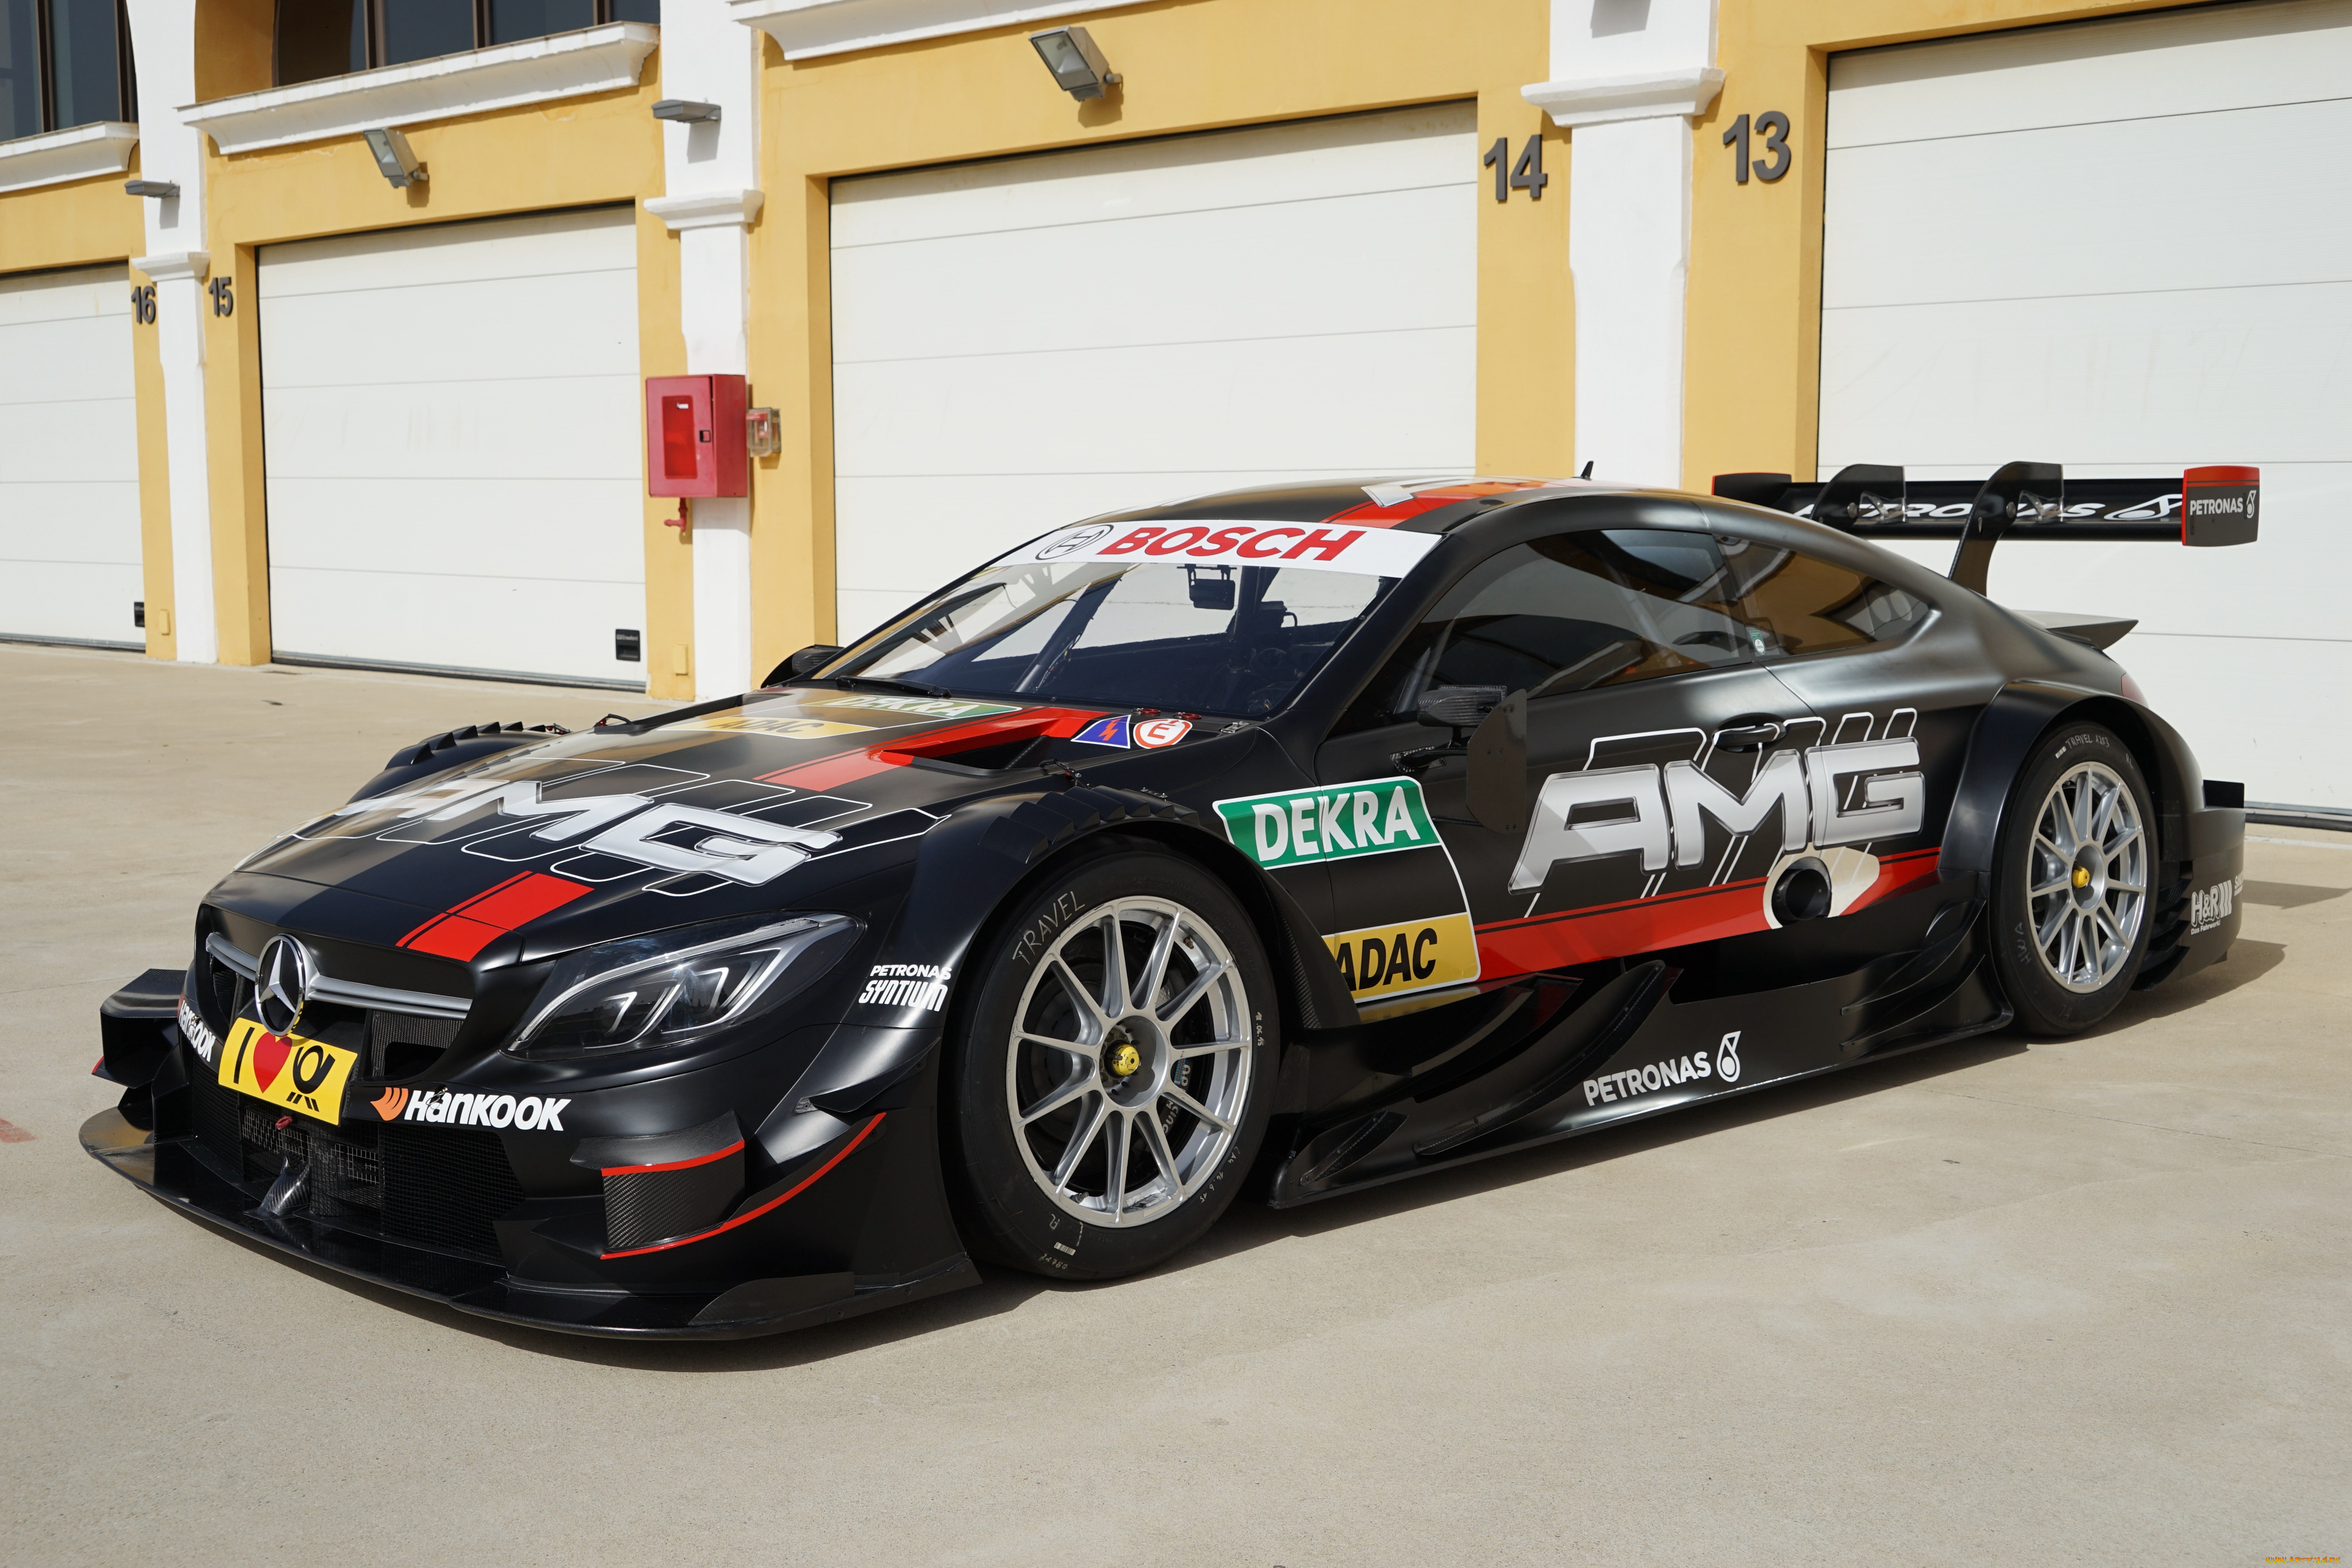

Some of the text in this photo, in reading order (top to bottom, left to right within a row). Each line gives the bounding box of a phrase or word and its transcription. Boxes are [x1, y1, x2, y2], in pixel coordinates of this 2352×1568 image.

[1723, 111, 1791, 183] 13
[1483, 134, 1548, 202] 14
[131, 286, 156, 324] 16
[208, 277, 233, 316] 15
[2190, 497, 2243, 515] PETRONAS
[1096, 526, 1367, 561] BOSCH
[704, 719, 825, 733] ADAC
[822, 696, 980, 717] DEKRA
[2065, 734, 2092, 749] TRAVEL
[333, 778, 843, 887] AMG
[1252, 785, 1421, 861] DEKRA
[1508, 737, 1925, 895] AMG
[2191, 885, 2221, 927] H&R
[1012, 891, 1085, 965] TRAVEL
[870, 965, 952, 980] PETRONAS
[1336, 928, 1437, 992] ADAC
[858, 980, 947, 1012] SYNTIUM
[1583, 1051, 1712, 1106] PETRONAS
